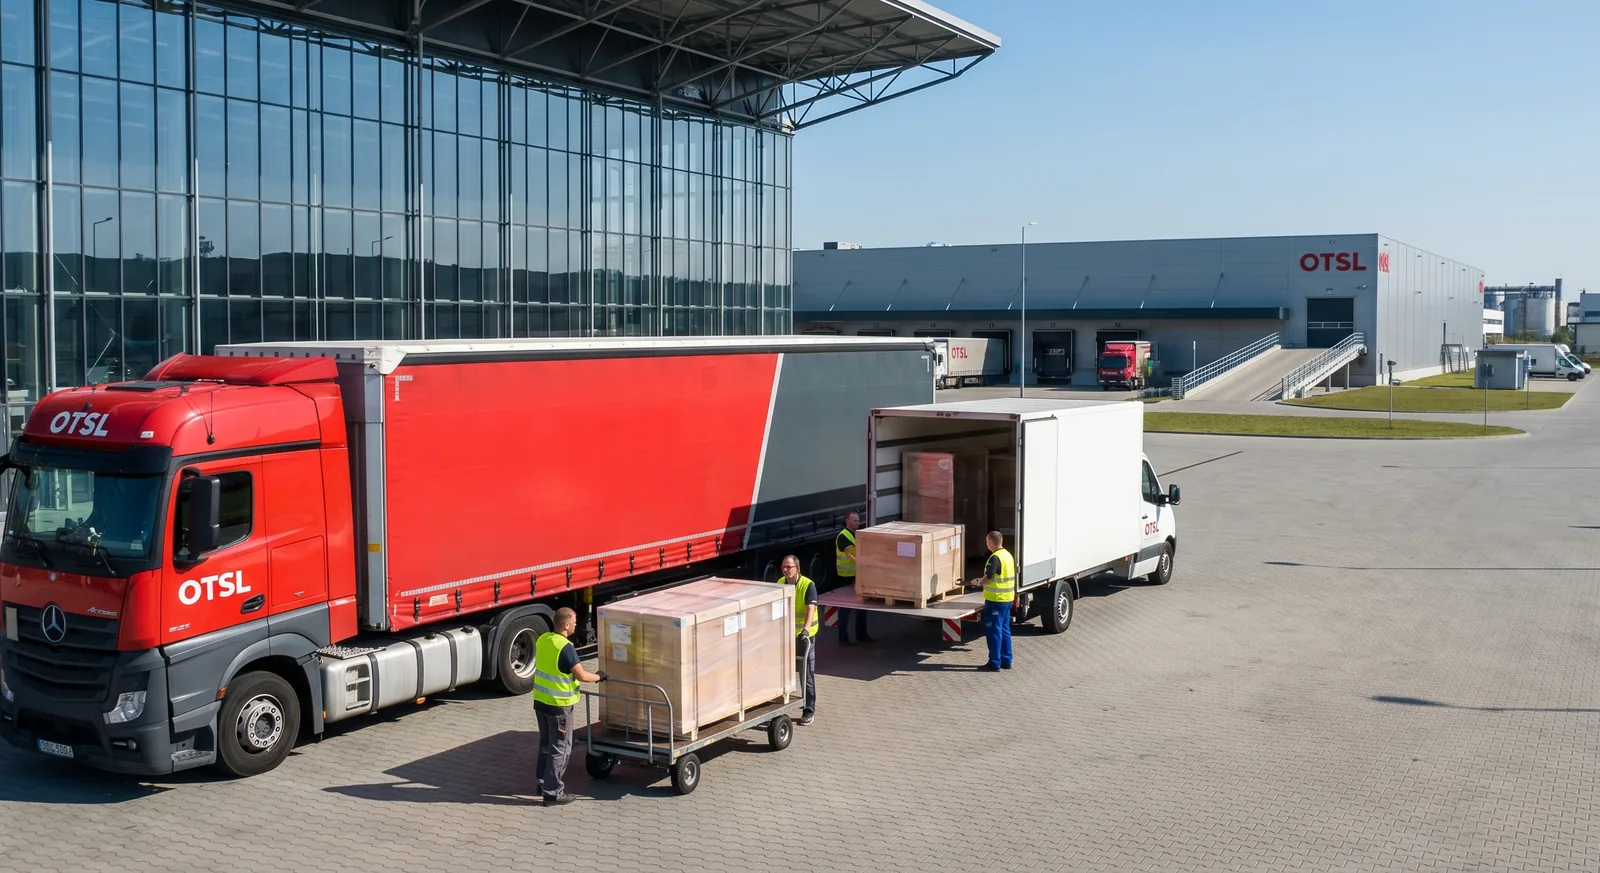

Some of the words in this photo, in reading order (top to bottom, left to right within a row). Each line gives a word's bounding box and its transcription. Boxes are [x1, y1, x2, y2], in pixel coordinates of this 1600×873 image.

[1300, 252, 1366, 272] OTSL
[951, 347, 968, 359] OTSL
[50, 411, 109, 437] OTSL
[178, 569, 252, 606] OTSL
